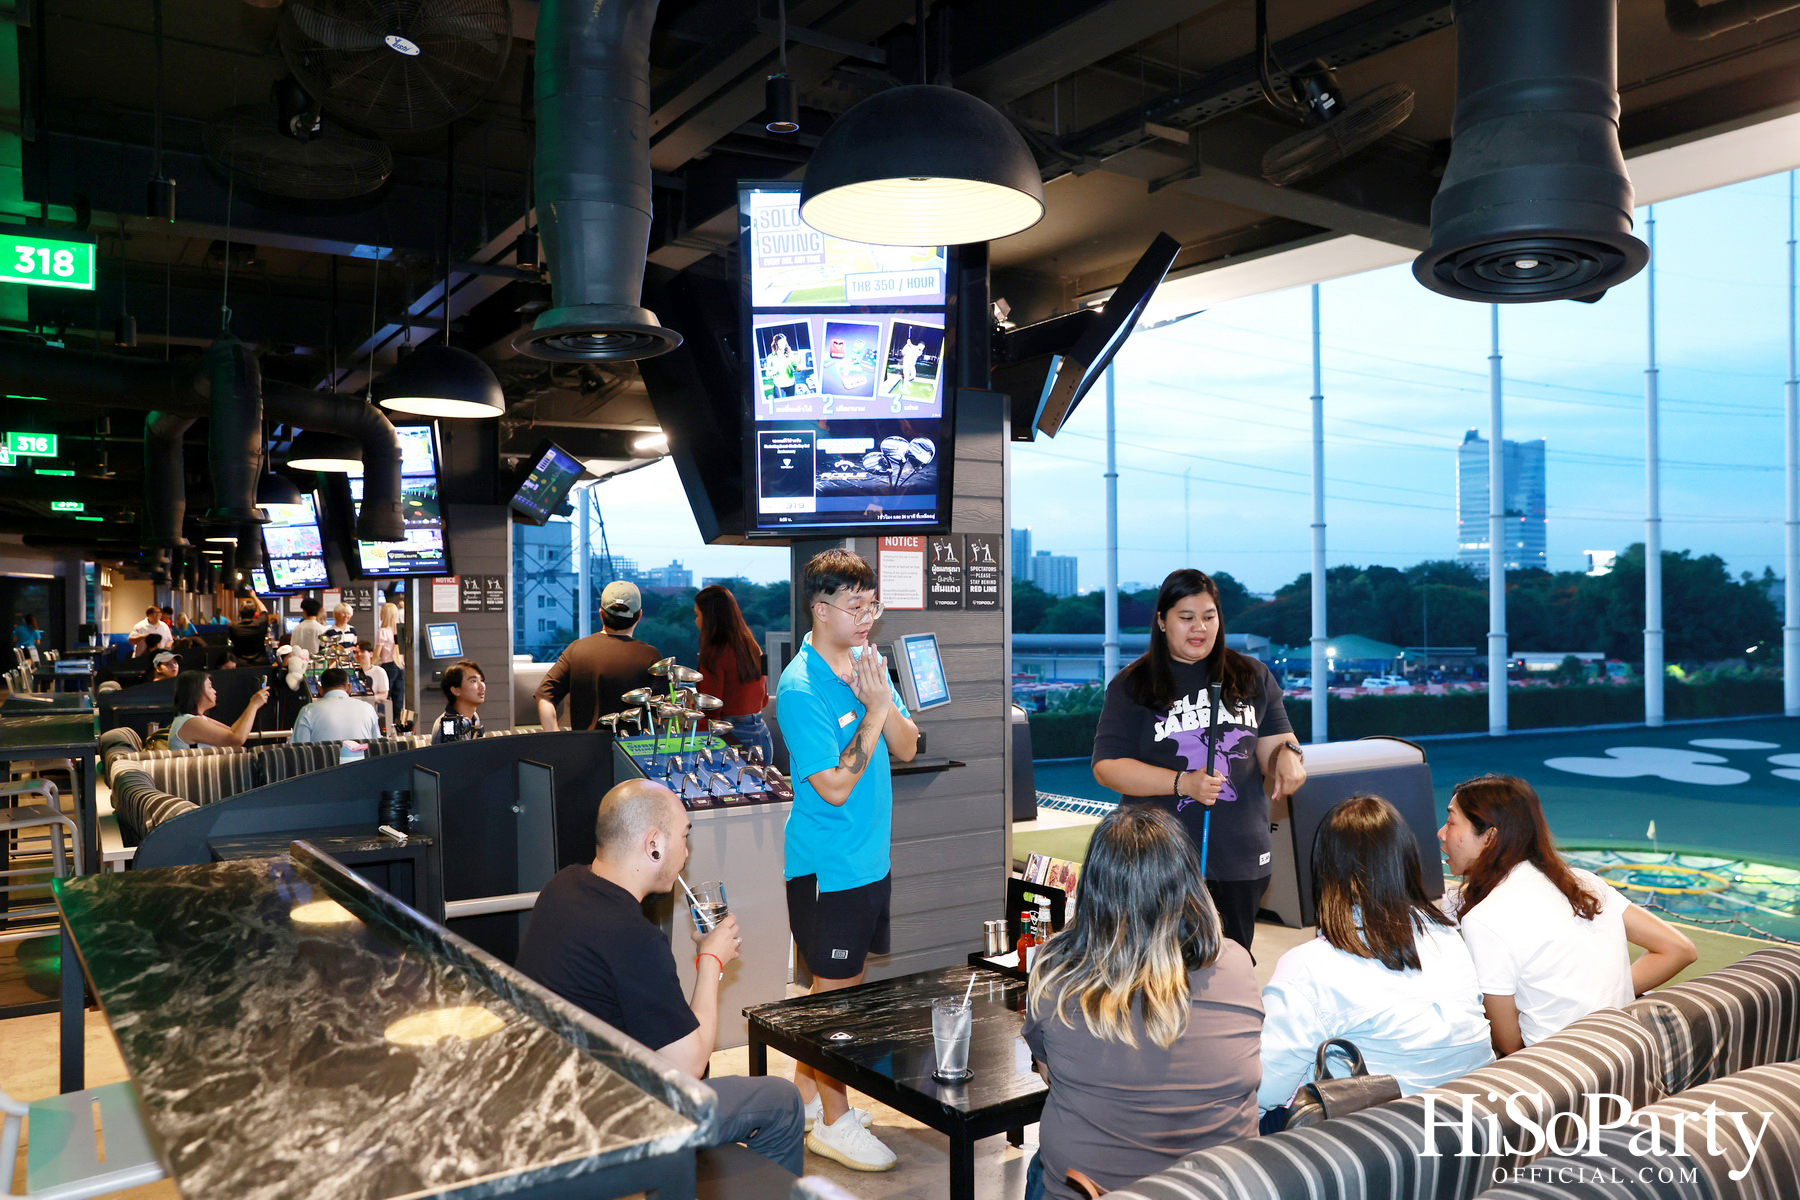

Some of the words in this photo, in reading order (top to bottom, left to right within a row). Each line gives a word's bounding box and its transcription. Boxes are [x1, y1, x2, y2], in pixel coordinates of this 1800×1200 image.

[762, 232, 820, 254] SWING
[14, 245, 74, 277] 318
[852, 280, 871, 292] THB
[874, 279, 895, 291] 350
[907, 276, 935, 289] HOUR
[822, 394, 834, 415] 2
[890, 394, 902, 414] 3
[17, 436, 48, 452] 316
[885, 537, 918, 547] NOTICE
